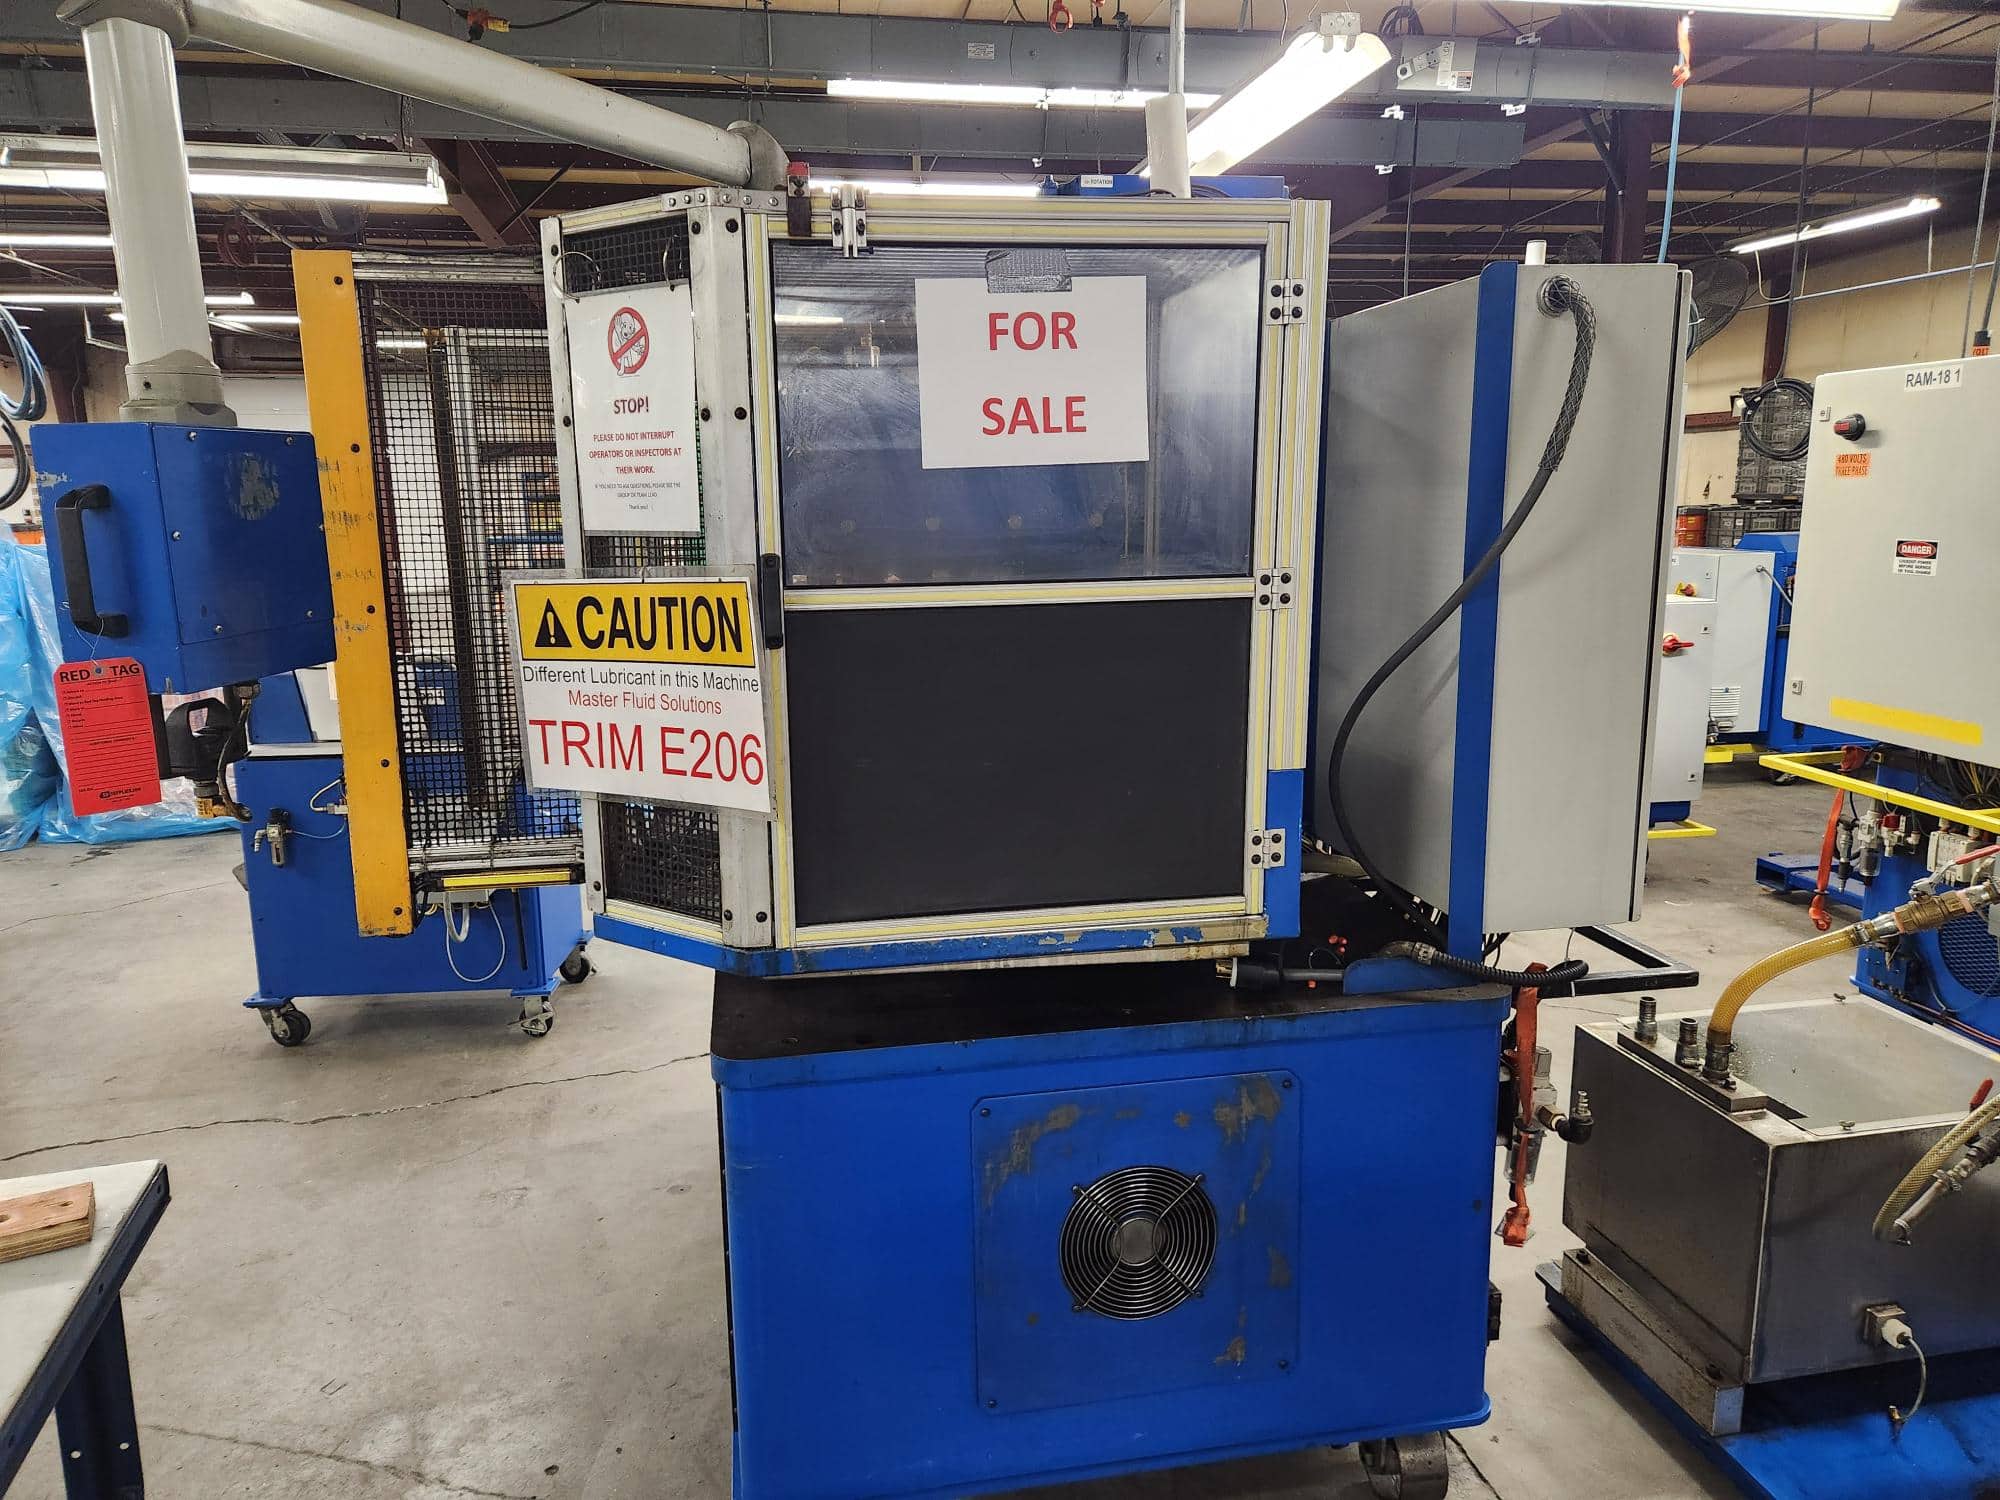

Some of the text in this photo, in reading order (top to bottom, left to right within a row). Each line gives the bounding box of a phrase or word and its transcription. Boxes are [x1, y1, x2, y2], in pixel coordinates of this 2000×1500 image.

[988, 311, 1078, 351] FOR
[1906, 369, 1950, 388] RAM-18
[613, 396, 649, 415] STOP!
[982, 396, 1087, 436] SALE
[593, 430, 675, 442] PLEASE DO NOT INTERRUPT
[589, 447, 682, 459] OPERATORS OR INSPECTORS AT
[1836, 453, 1868, 464] 480 VOLTS
[616, 465, 656, 474] THEIR WORK.
[1835, 465, 1868, 477] THREE PHASE
[1901, 545, 1932, 554] DANGER
[576, 595, 743, 653] CAUTION
[59, 664, 140, 682] RED TAG
[522, 666, 759, 693] Different Lubricant in this Machine
[568, 689, 722, 715] Master Fluid Solutions
[528, 719, 764, 786] TRIM E206
